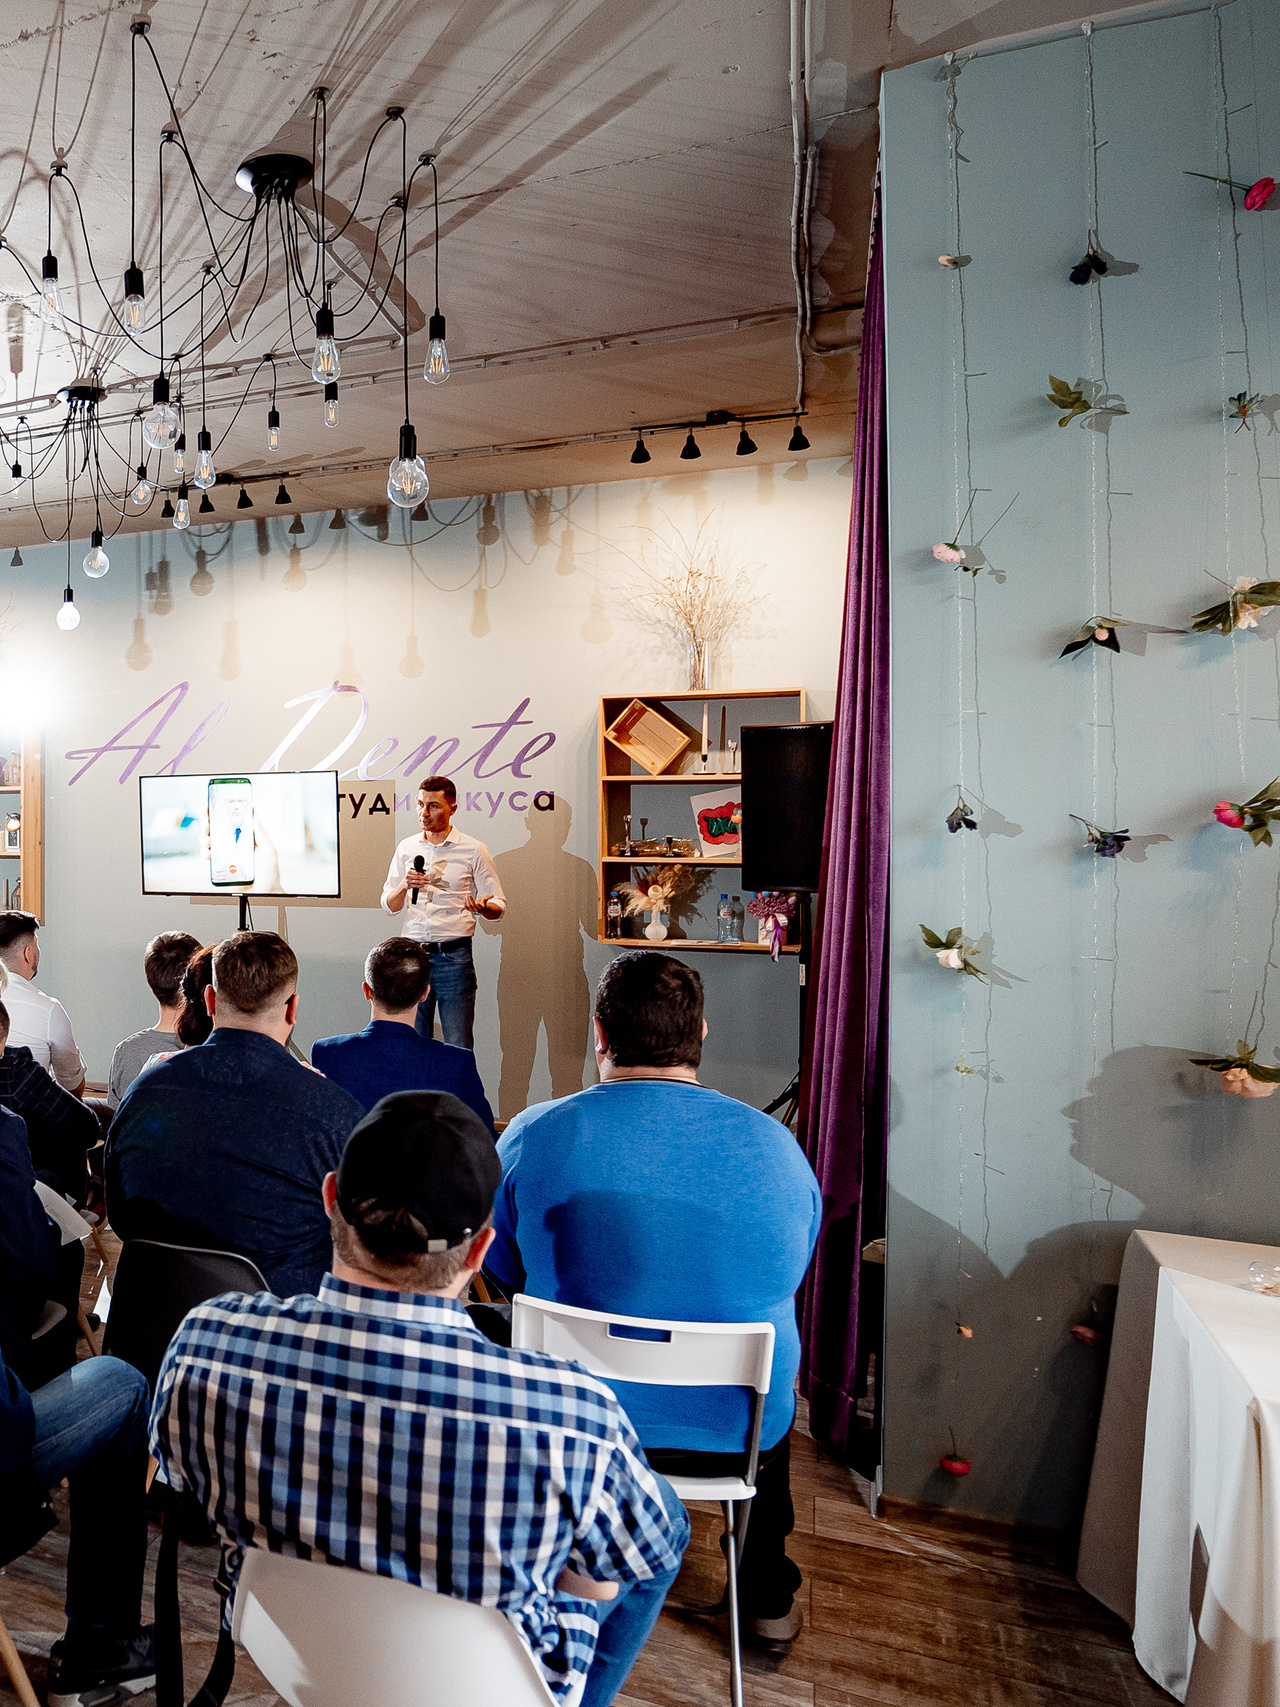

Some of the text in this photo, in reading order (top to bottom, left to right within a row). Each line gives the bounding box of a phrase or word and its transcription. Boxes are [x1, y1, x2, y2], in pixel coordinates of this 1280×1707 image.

[65, 680, 557, 786] Al Dente
[455, 790, 555, 818] куса
